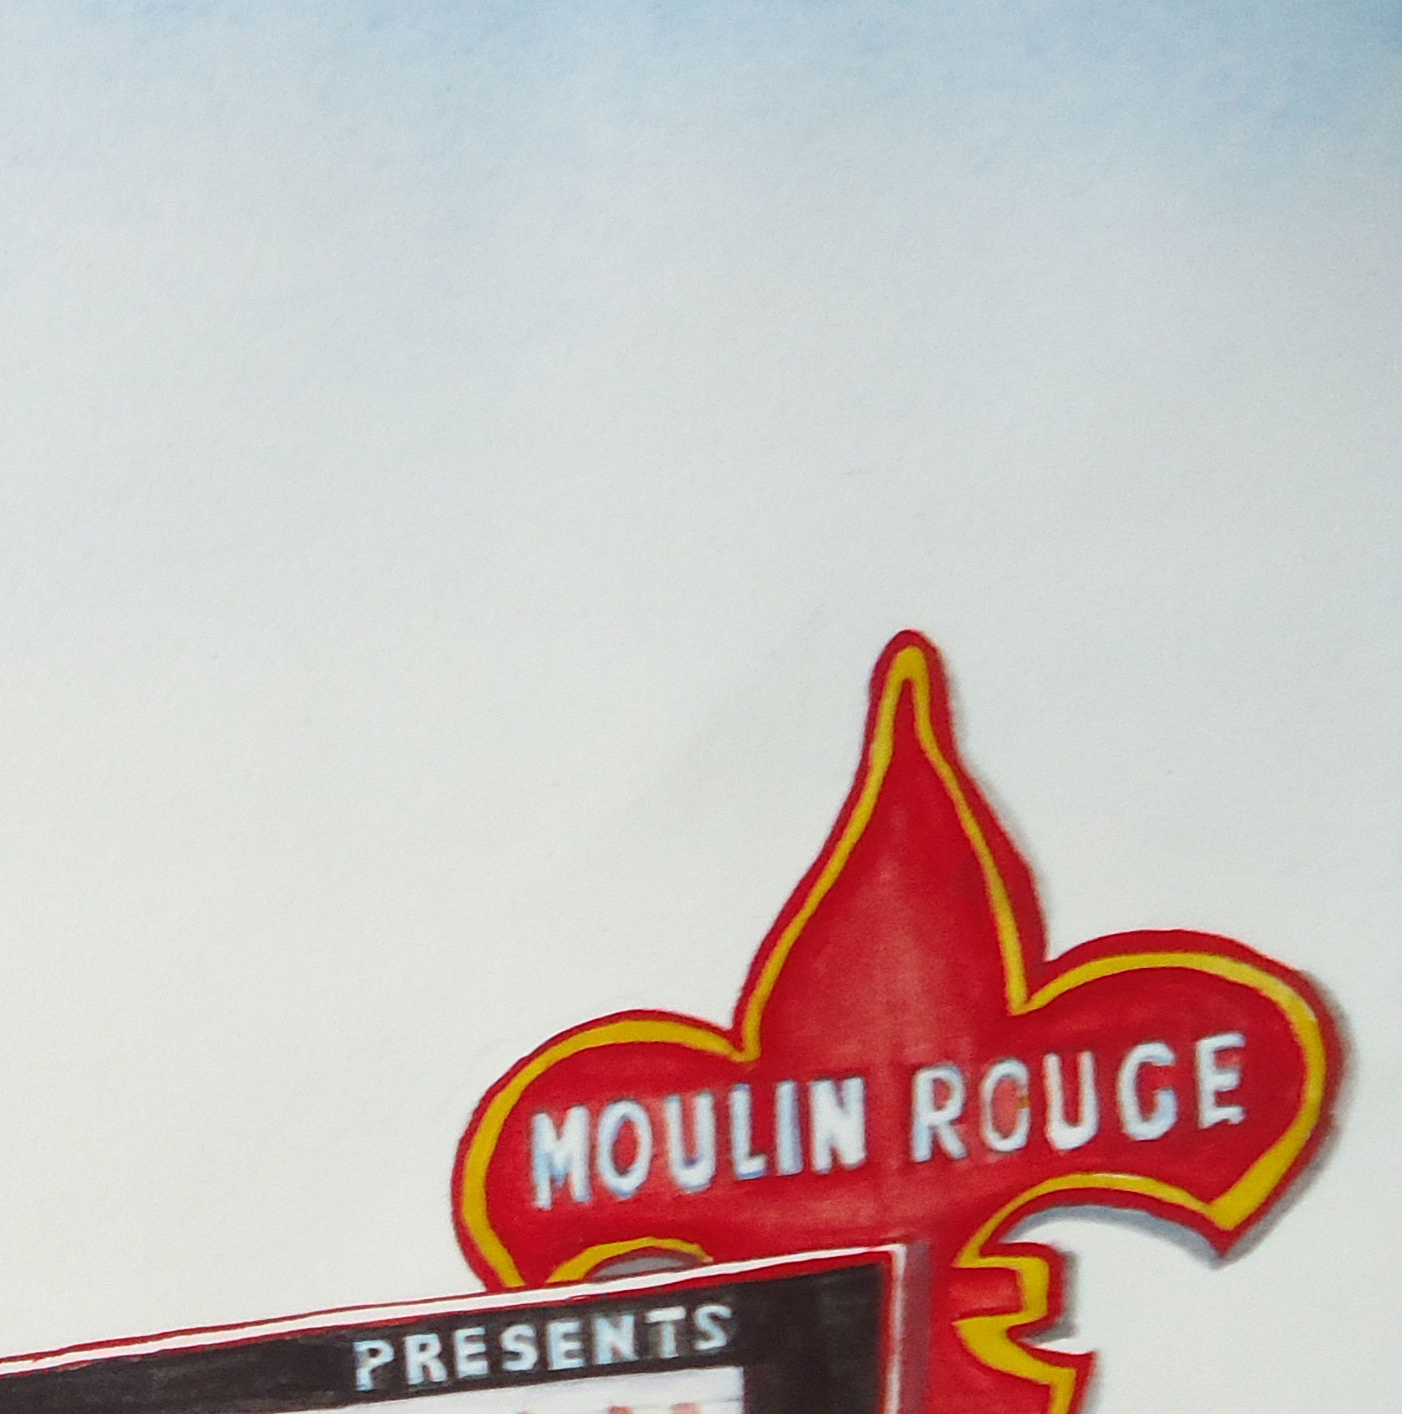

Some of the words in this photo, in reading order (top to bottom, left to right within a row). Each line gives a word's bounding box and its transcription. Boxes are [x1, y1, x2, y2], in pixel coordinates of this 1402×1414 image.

[531, 1076, 866, 1208] MOULIN
[911, 1031, 1246, 1164] ROUGE
[353, 1303, 736, 1391] PRESENTS
